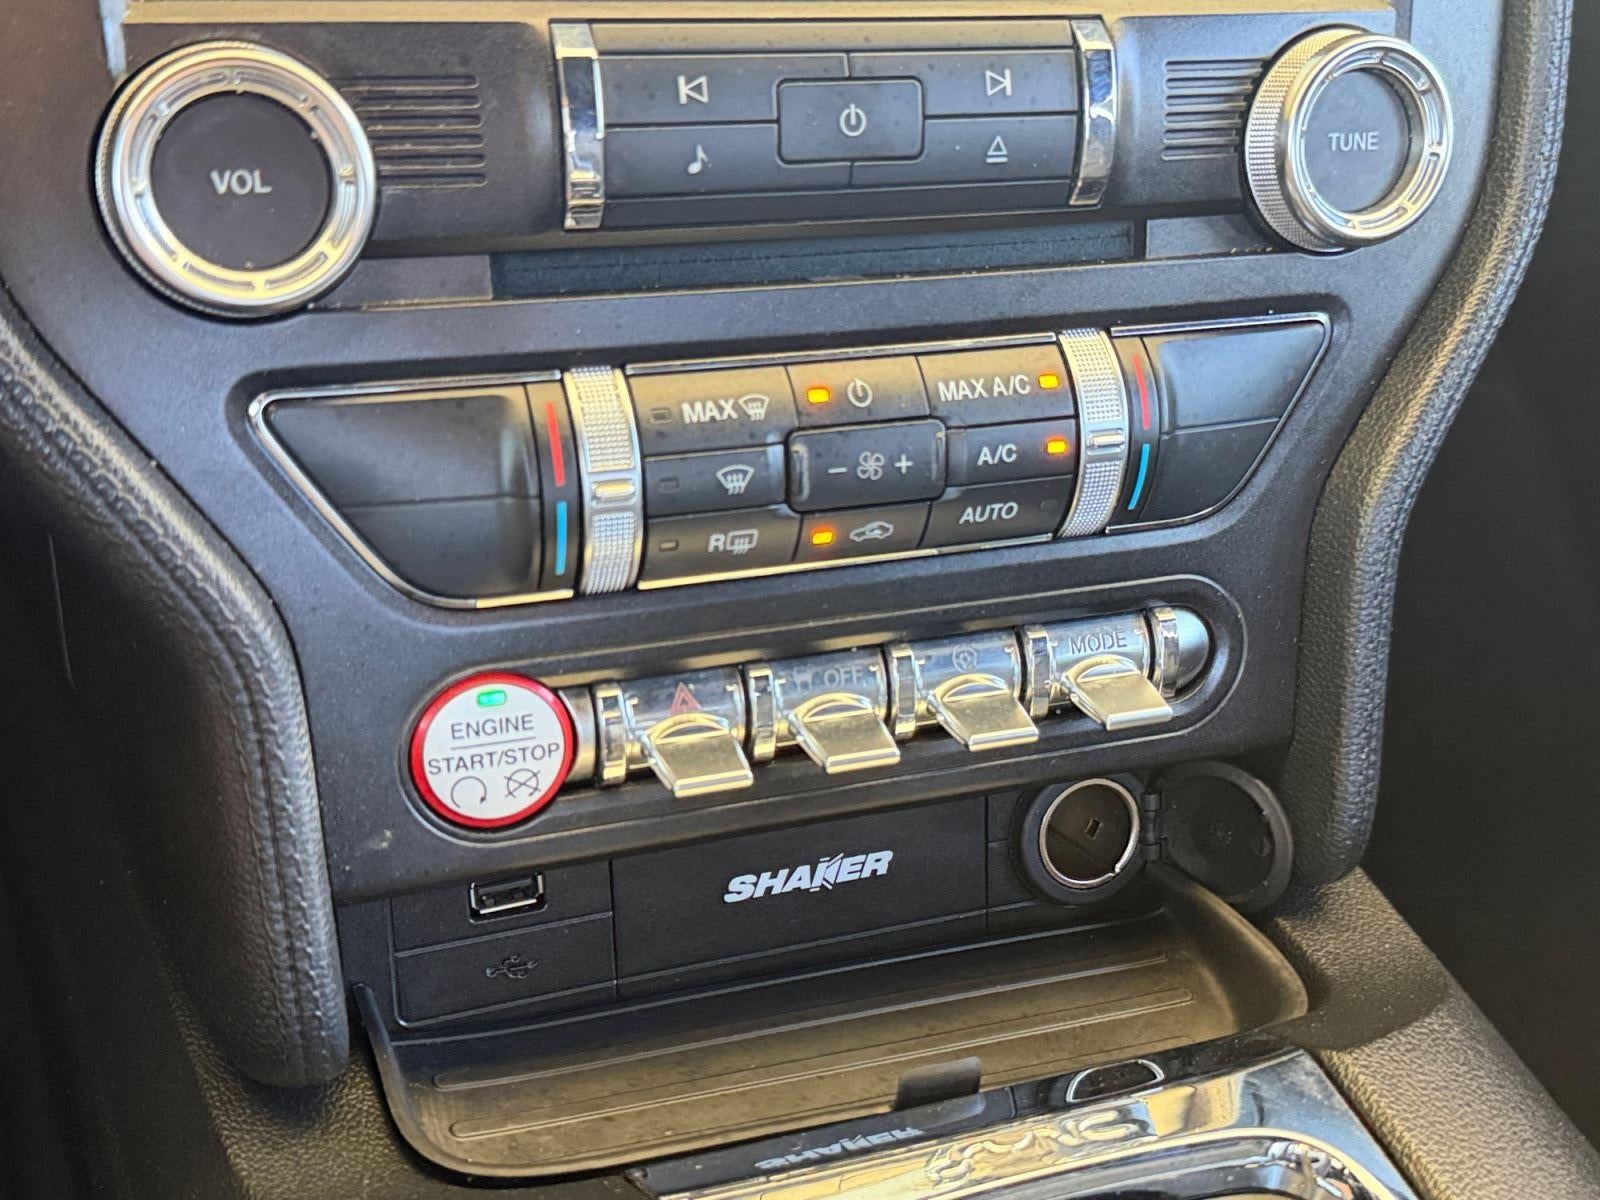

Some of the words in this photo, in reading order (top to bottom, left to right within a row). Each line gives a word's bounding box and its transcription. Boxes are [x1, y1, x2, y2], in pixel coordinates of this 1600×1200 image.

[1328, 131, 1380, 151] TUNE
[210, 169, 273, 195] VOL
[938, 378, 988, 402] MAX
[993, 374, 1030, 397] A/C
[681, 398, 738, 424] MAX
[977, 443, 1018, 466] A/C
[959, 502, 1018, 524] AUTO
[1068, 630, 1128, 655] MODE
[823, 663, 864, 688] OFF
[451, 713, 535, 740] ENGINE
[428, 742, 560, 775] START/STOP
[723, 850, 893, 903] SHAKER
